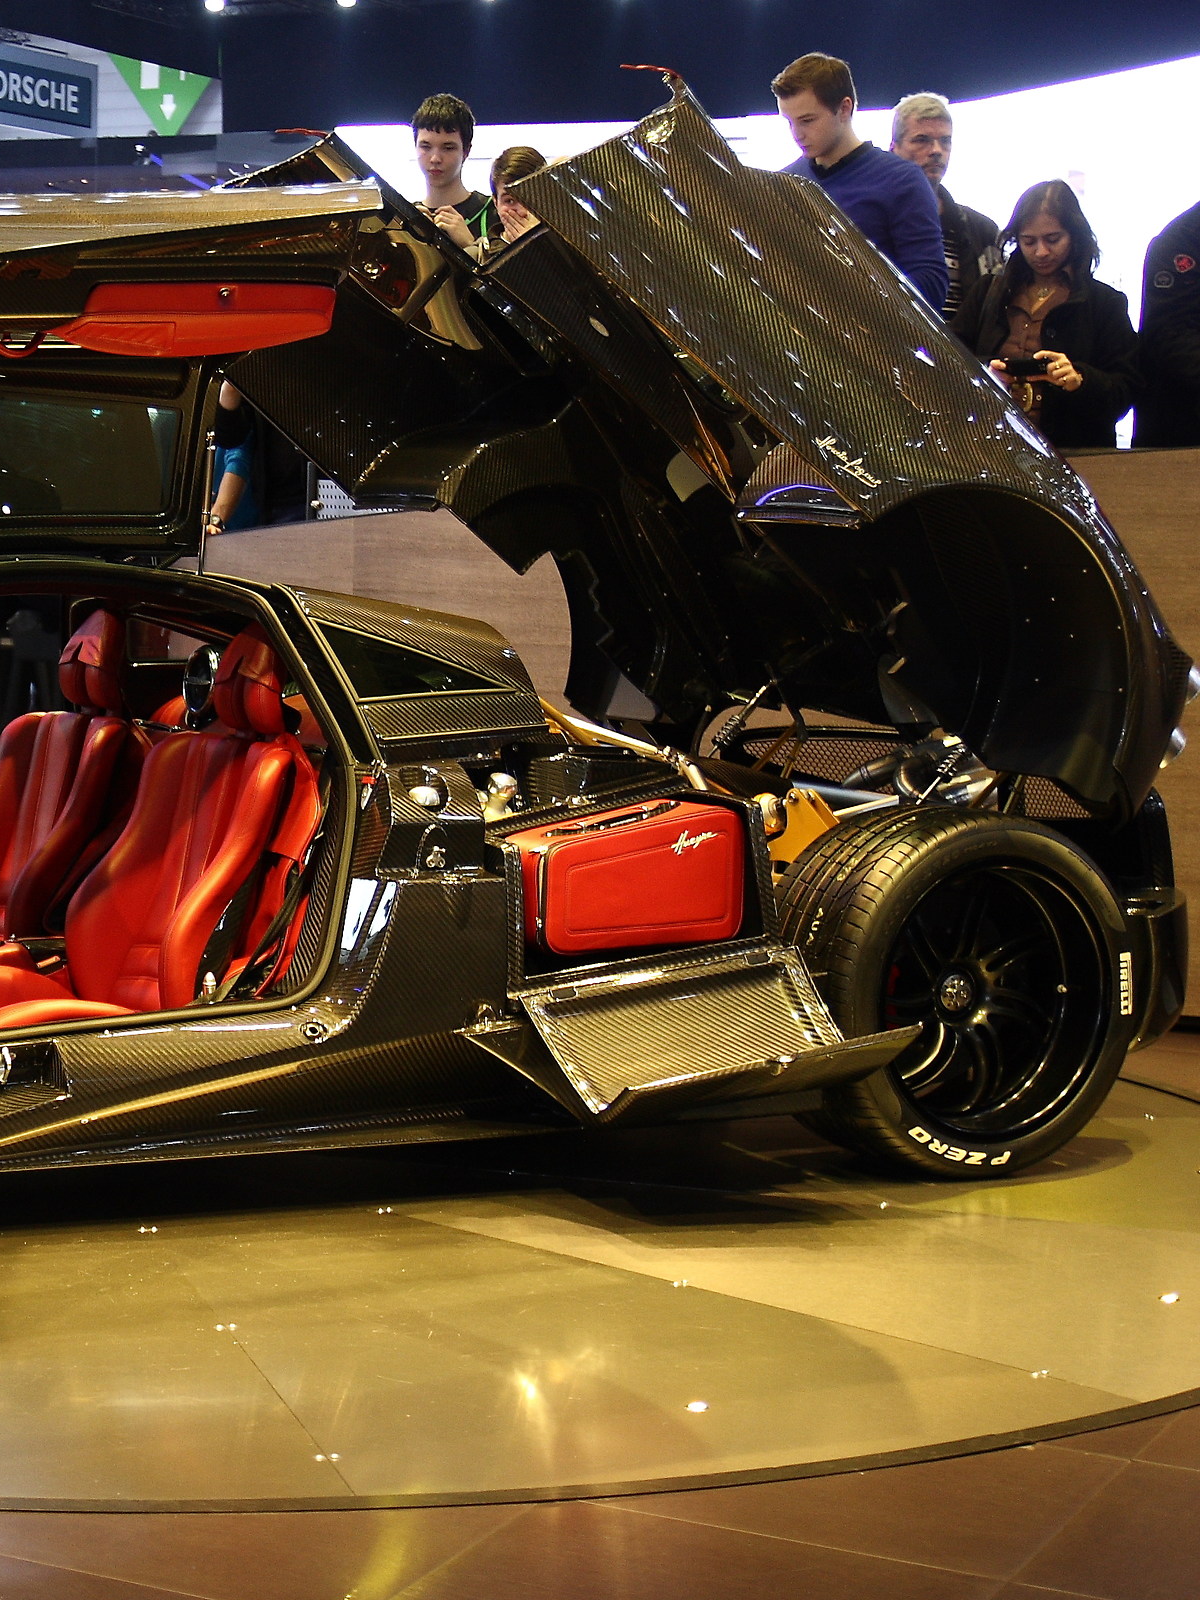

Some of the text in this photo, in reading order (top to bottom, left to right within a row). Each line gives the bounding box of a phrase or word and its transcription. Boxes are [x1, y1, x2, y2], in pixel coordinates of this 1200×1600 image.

[1120, 951, 1133, 1016] PIRELLI
[907, 1126, 1011, 1166] P ZERO
